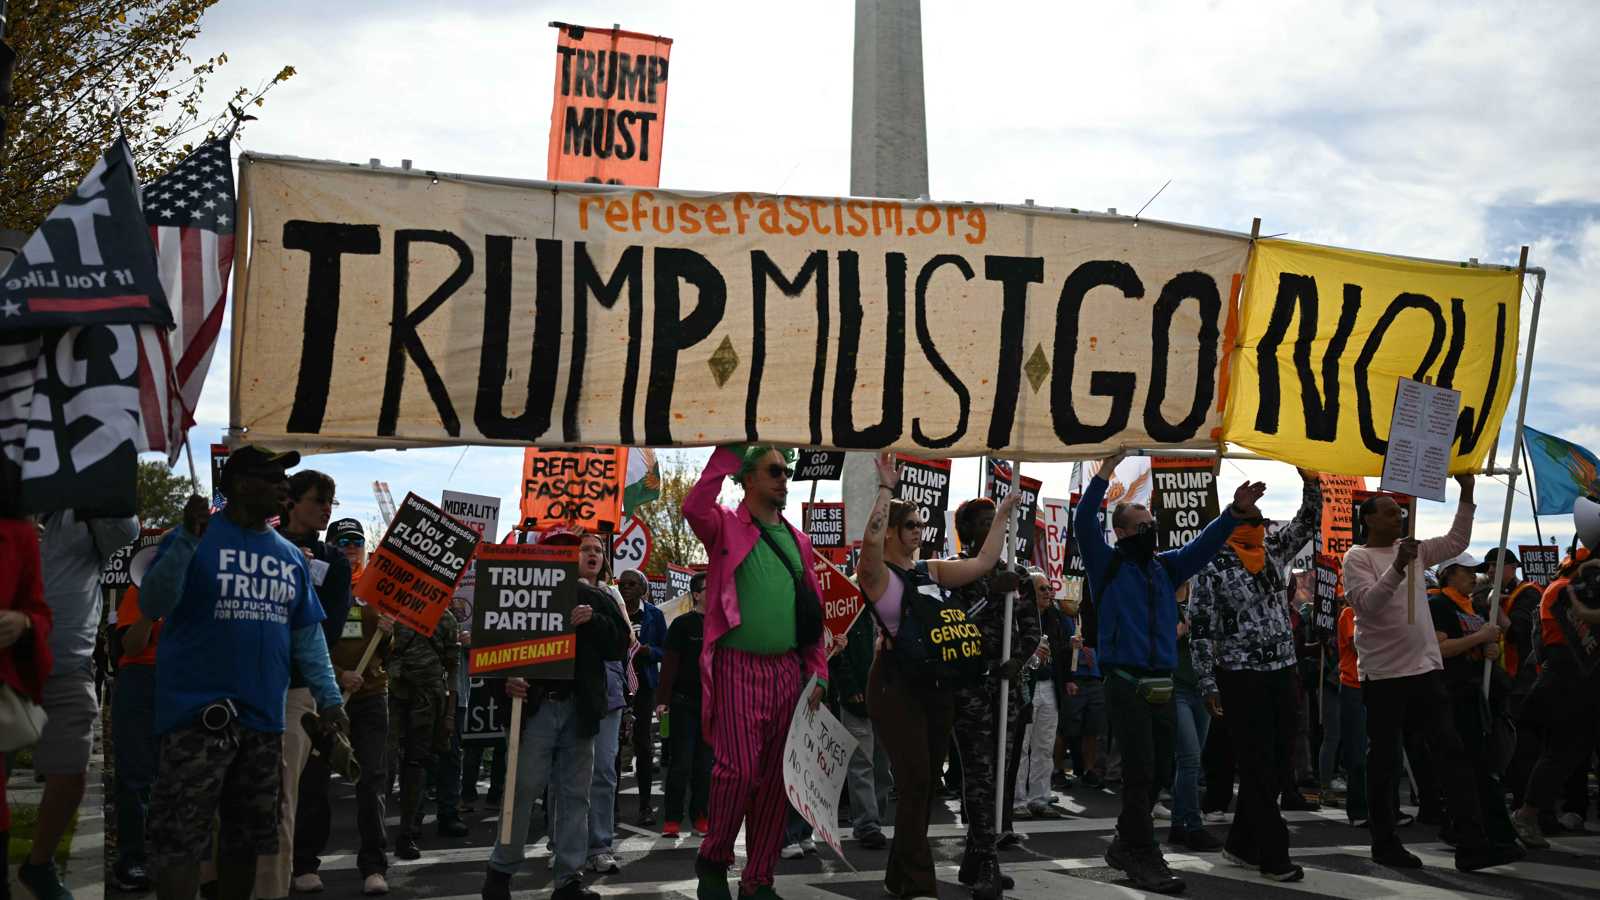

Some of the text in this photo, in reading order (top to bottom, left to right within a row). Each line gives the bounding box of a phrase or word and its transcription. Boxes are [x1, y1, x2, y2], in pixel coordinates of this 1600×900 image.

[557, 45, 669, 104] TRUMP
[563, 106, 657, 161] MUST
[577, 191, 988, 245] refusefascism.org
[282, 219, 728, 446] TRUMP
[744, 247, 1045, 450] MUST
[1254, 272, 1507, 457] NOW
[532, 456, 617, 480] REFUSE
[811, 452, 829, 464] GO
[801, 464, 836, 477] NOW!
[900, 465, 947, 489] TRUMP
[1155, 472, 1213, 491] TRUMP
[525, 479, 620, 503] FASCISM
[901, 484, 942, 507] MUST
[995, 479, 1036, 506] TRMP
[1163, 490, 1209, 510] MUST
[406, 496, 441, 522] Beginning
[443, 499, 499, 521] MORALITY
[829, 508, 842, 520] SE
[1175, 510, 1200, 528] GO
[416, 517, 458, 549] Nov 5
[810, 520, 843, 533] ARGUE
[387, 533, 402, 549] with
[401, 543, 435, 569] nonviolent
[432, 561, 459, 581] protest
[392, 521, 443, 558] FLOOD
[441, 549, 466, 571] DC
[218, 548, 297, 585] FUCK
[488, 567, 566, 587] TRUMP
[216, 572, 296, 604] TRUMP
[374, 554, 414, 586] TRUMP
[414, 579, 448, 605] MUST
[1318, 582, 1336, 600] MUST
[215, 599, 240, 610] AND
[242, 600, 272, 612] FUCK
[376, 577, 427, 615] GO NOW!
[499, 589, 552, 609] DOIT
[825, 596, 859, 620] RIGHT
[1321, 599, 1332, 614] GO
[214, 609, 231, 620] FOR
[484, 611, 563, 632] PARTIR
[475, 640, 570, 668] MAINTENANT!
